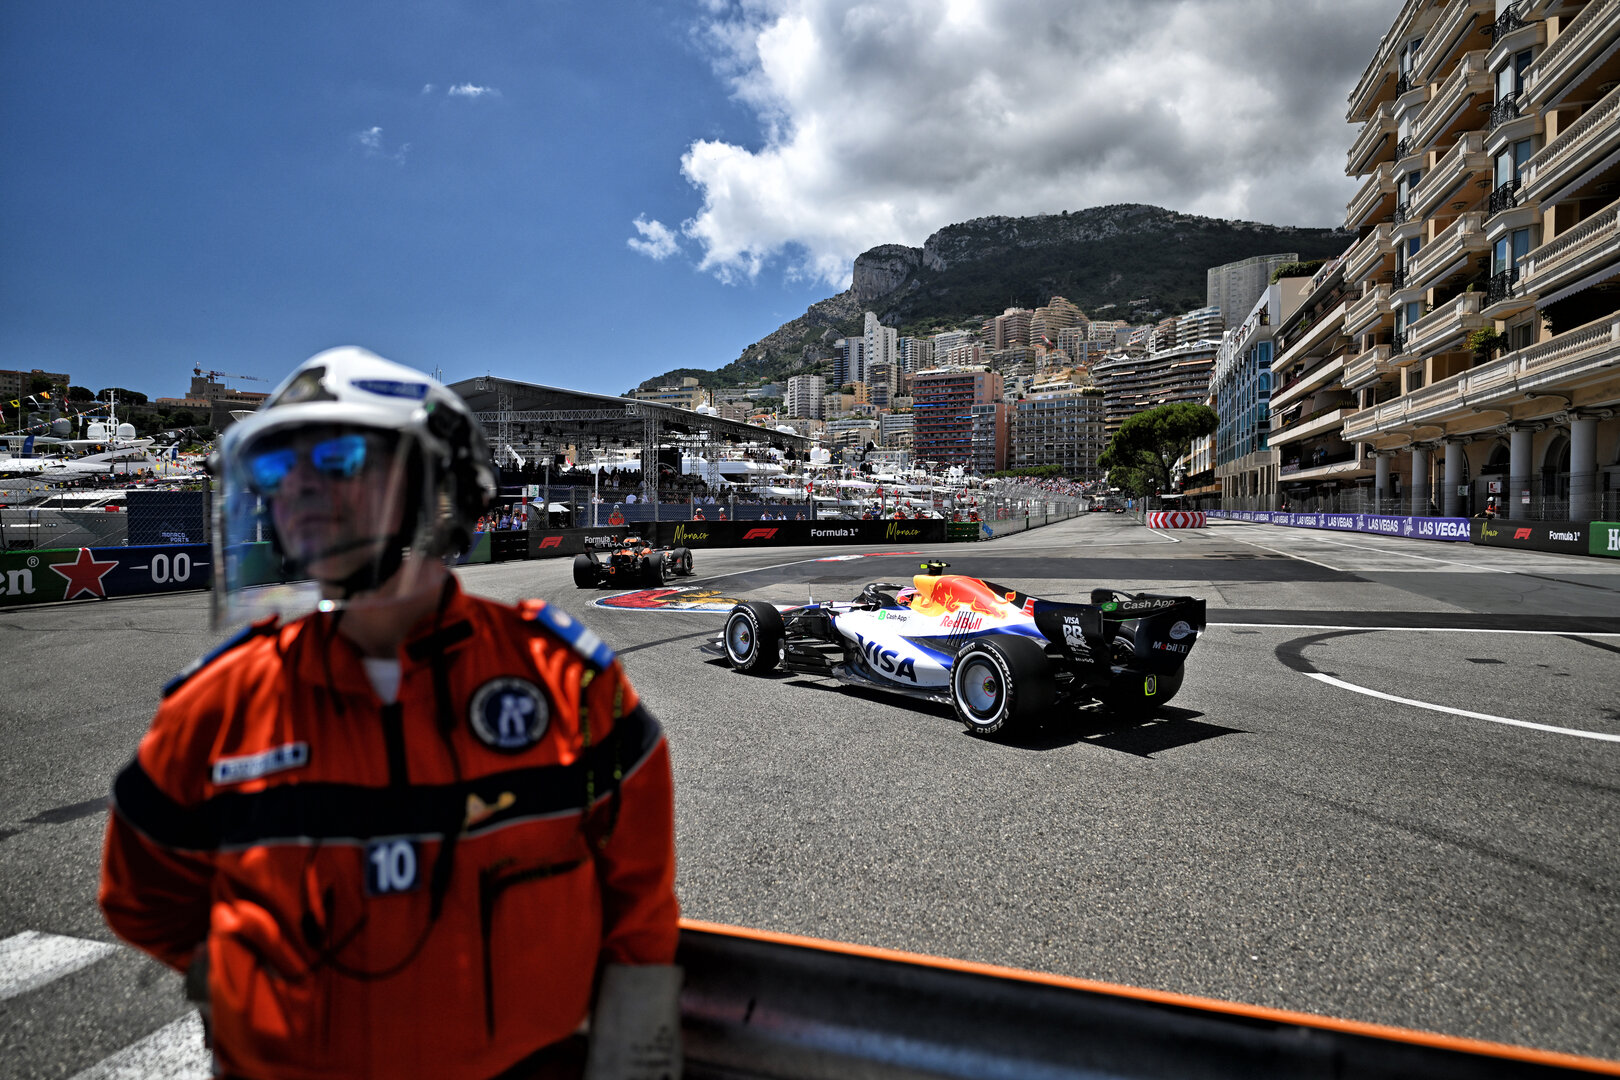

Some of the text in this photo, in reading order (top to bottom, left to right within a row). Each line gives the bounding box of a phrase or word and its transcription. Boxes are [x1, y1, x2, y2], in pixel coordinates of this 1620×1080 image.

[1327, 516, 1337, 527] LAS
[1336, 516, 1353, 528] VEGAS
[1367, 518, 1379, 531] LAS
[1379, 518, 1399, 533] VEGAS
[1418, 521, 1433, 535] LAS
[673, 524, 709, 546] Monaco
[810, 528, 849, 537] Formula
[885, 522, 920, 541] Monaco
[1549, 530, 1574, 541] Formula
[151, 552, 191, 584] 0.0
[1122, 599, 1176, 610] Cash App
[886, 612, 908, 622] Cash App
[939, 615, 983, 630] Red Bull
[1062, 615, 1080, 625] VISA
[1152, 641, 1178, 652] Mobil
[855, 631, 917, 684] VISA
[370, 839, 417, 892] 10
